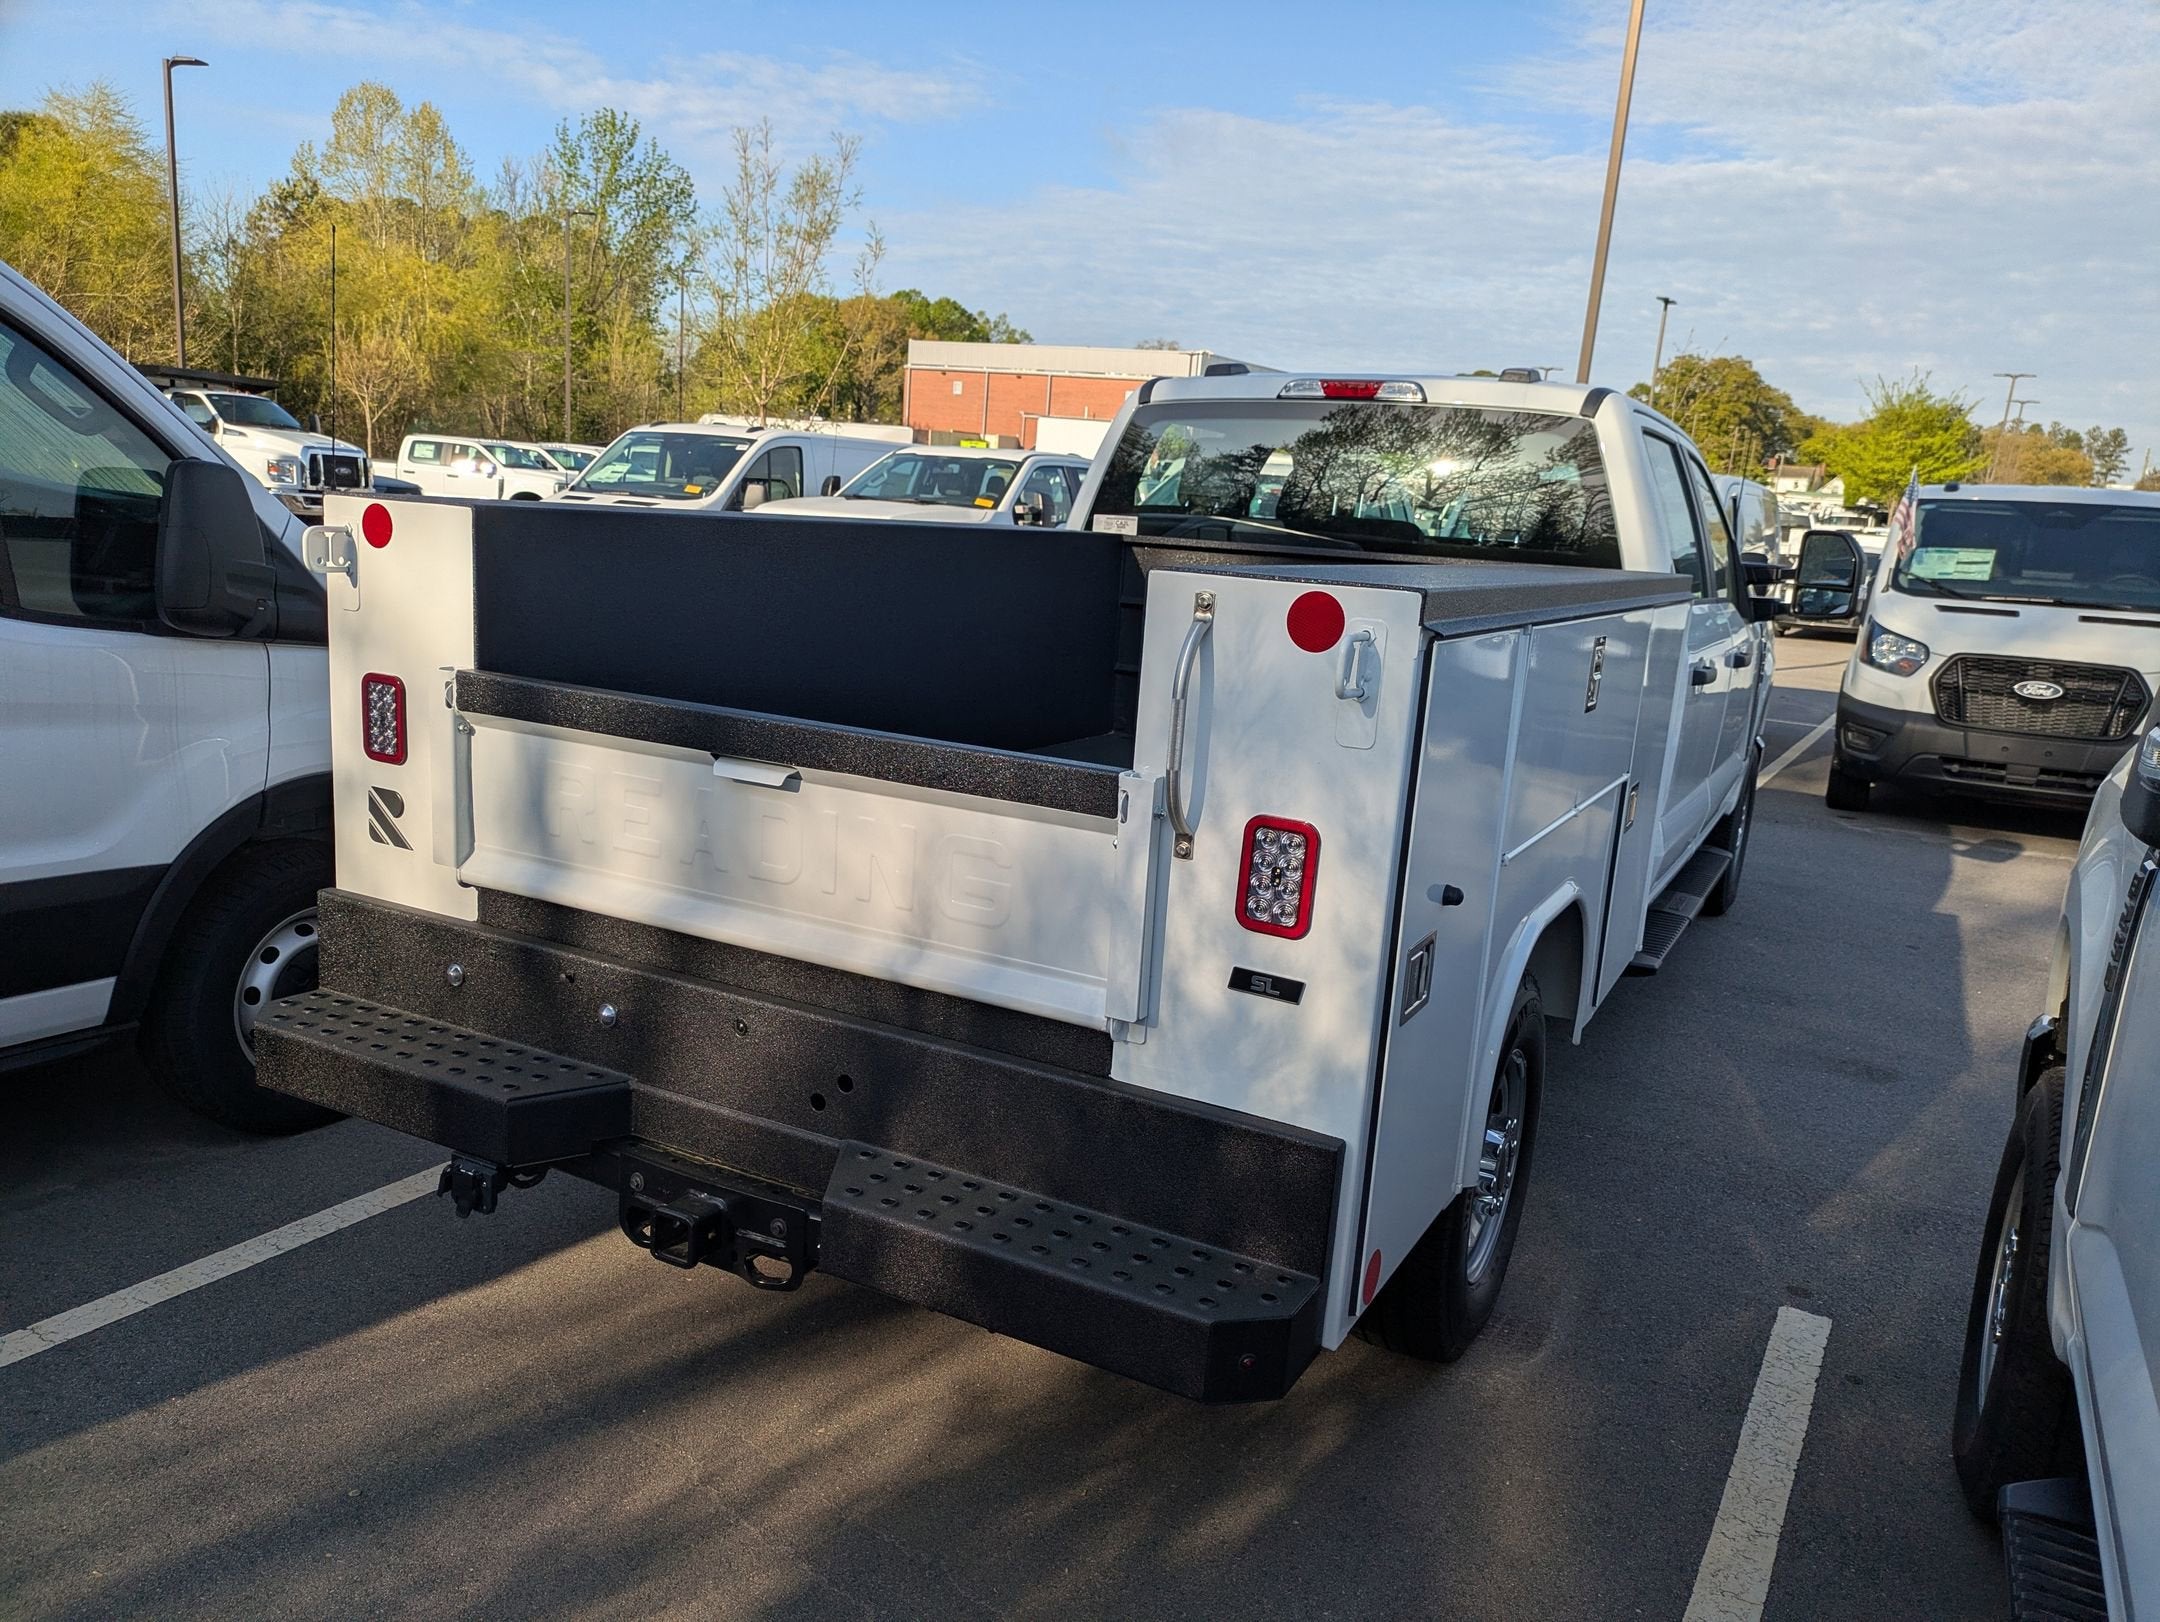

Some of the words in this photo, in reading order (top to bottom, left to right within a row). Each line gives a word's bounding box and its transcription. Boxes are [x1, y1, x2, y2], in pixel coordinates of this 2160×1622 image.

[2022, 683, 2055, 697] Ford
[548, 758, 1013, 929] READING
[1250, 974, 1280, 996] SL
